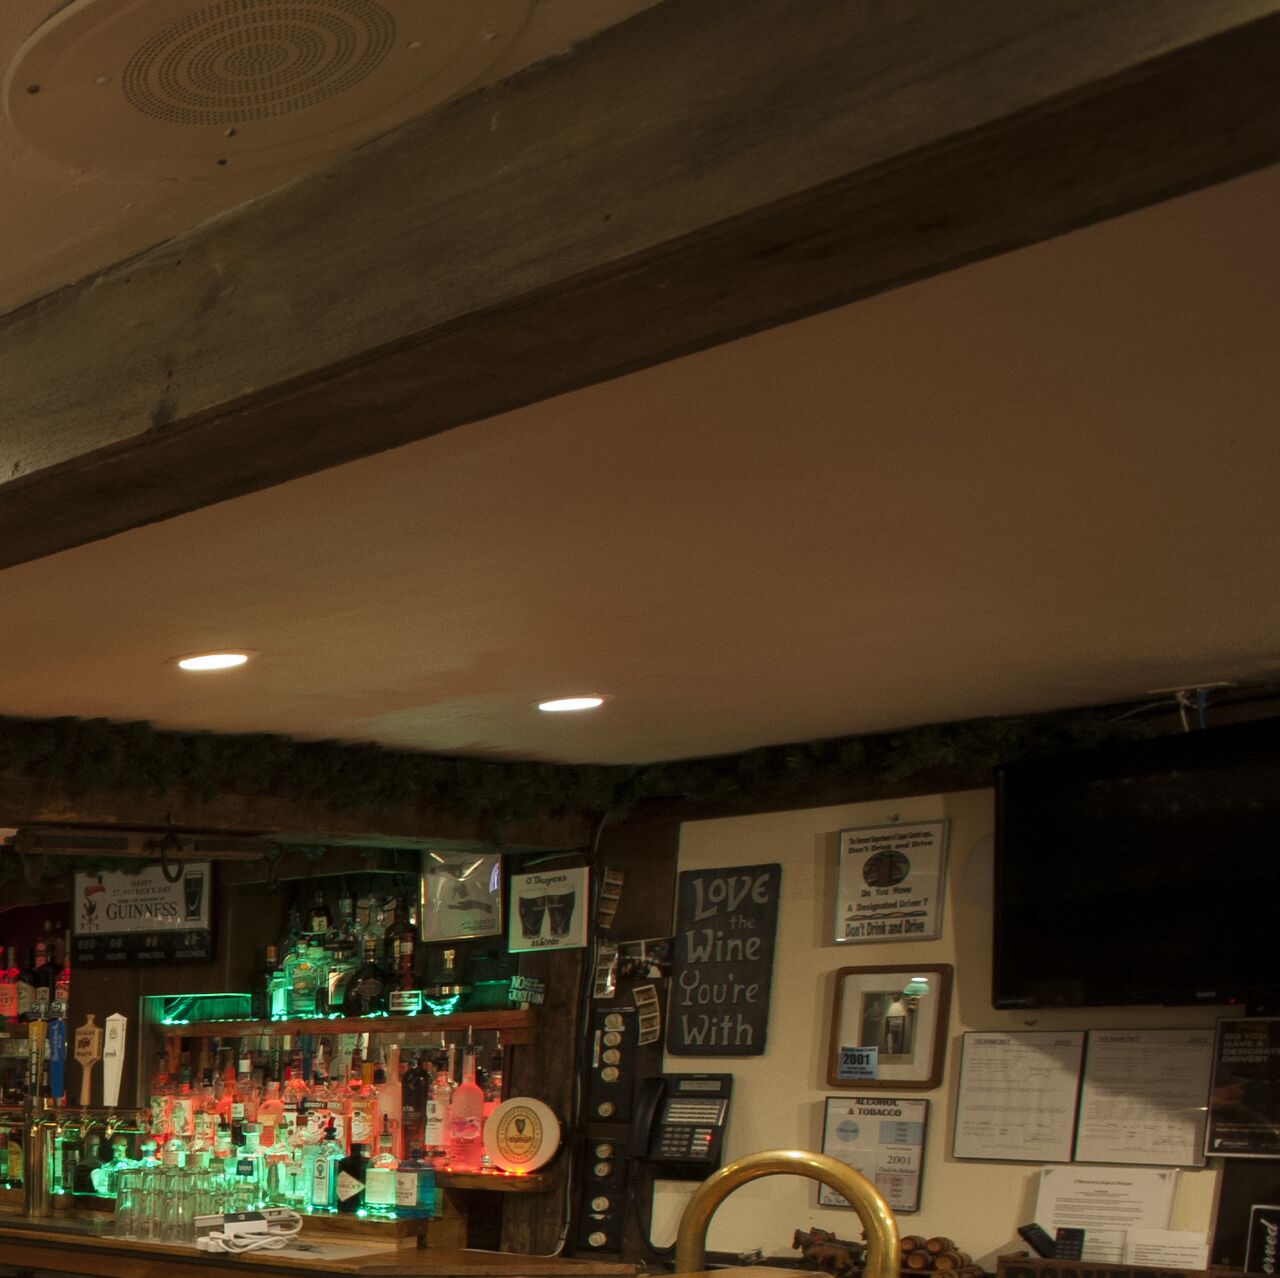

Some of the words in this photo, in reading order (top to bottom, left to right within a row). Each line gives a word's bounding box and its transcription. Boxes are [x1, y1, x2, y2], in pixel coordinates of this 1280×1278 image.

[912, 840, 933, 848] Drive
[862, 889, 871, 897] Do
[876, 888, 889, 896] You
[106, 901, 177, 920] GUINNESS
[847, 904, 852, 912] A
[730, 914, 756, 929] the
[845, 922, 865, 937] Don't
[867, 921, 887, 936] Drink
[888, 919, 903, 934] and
[905, 918, 925, 933] Drive
[685, 928, 761, 964] Wine
[679, 970, 759, 1006] You're
[681, 1014, 753, 1046] With
[1224, 1032, 1241, 1040] DO
[1244, 1032, 1268, 1040] YOU
[843, 1052, 870, 1066] 2001
[858, 1108, 902, 1117] TOBACCO
[886, 1154, 912, 1166] 2001
